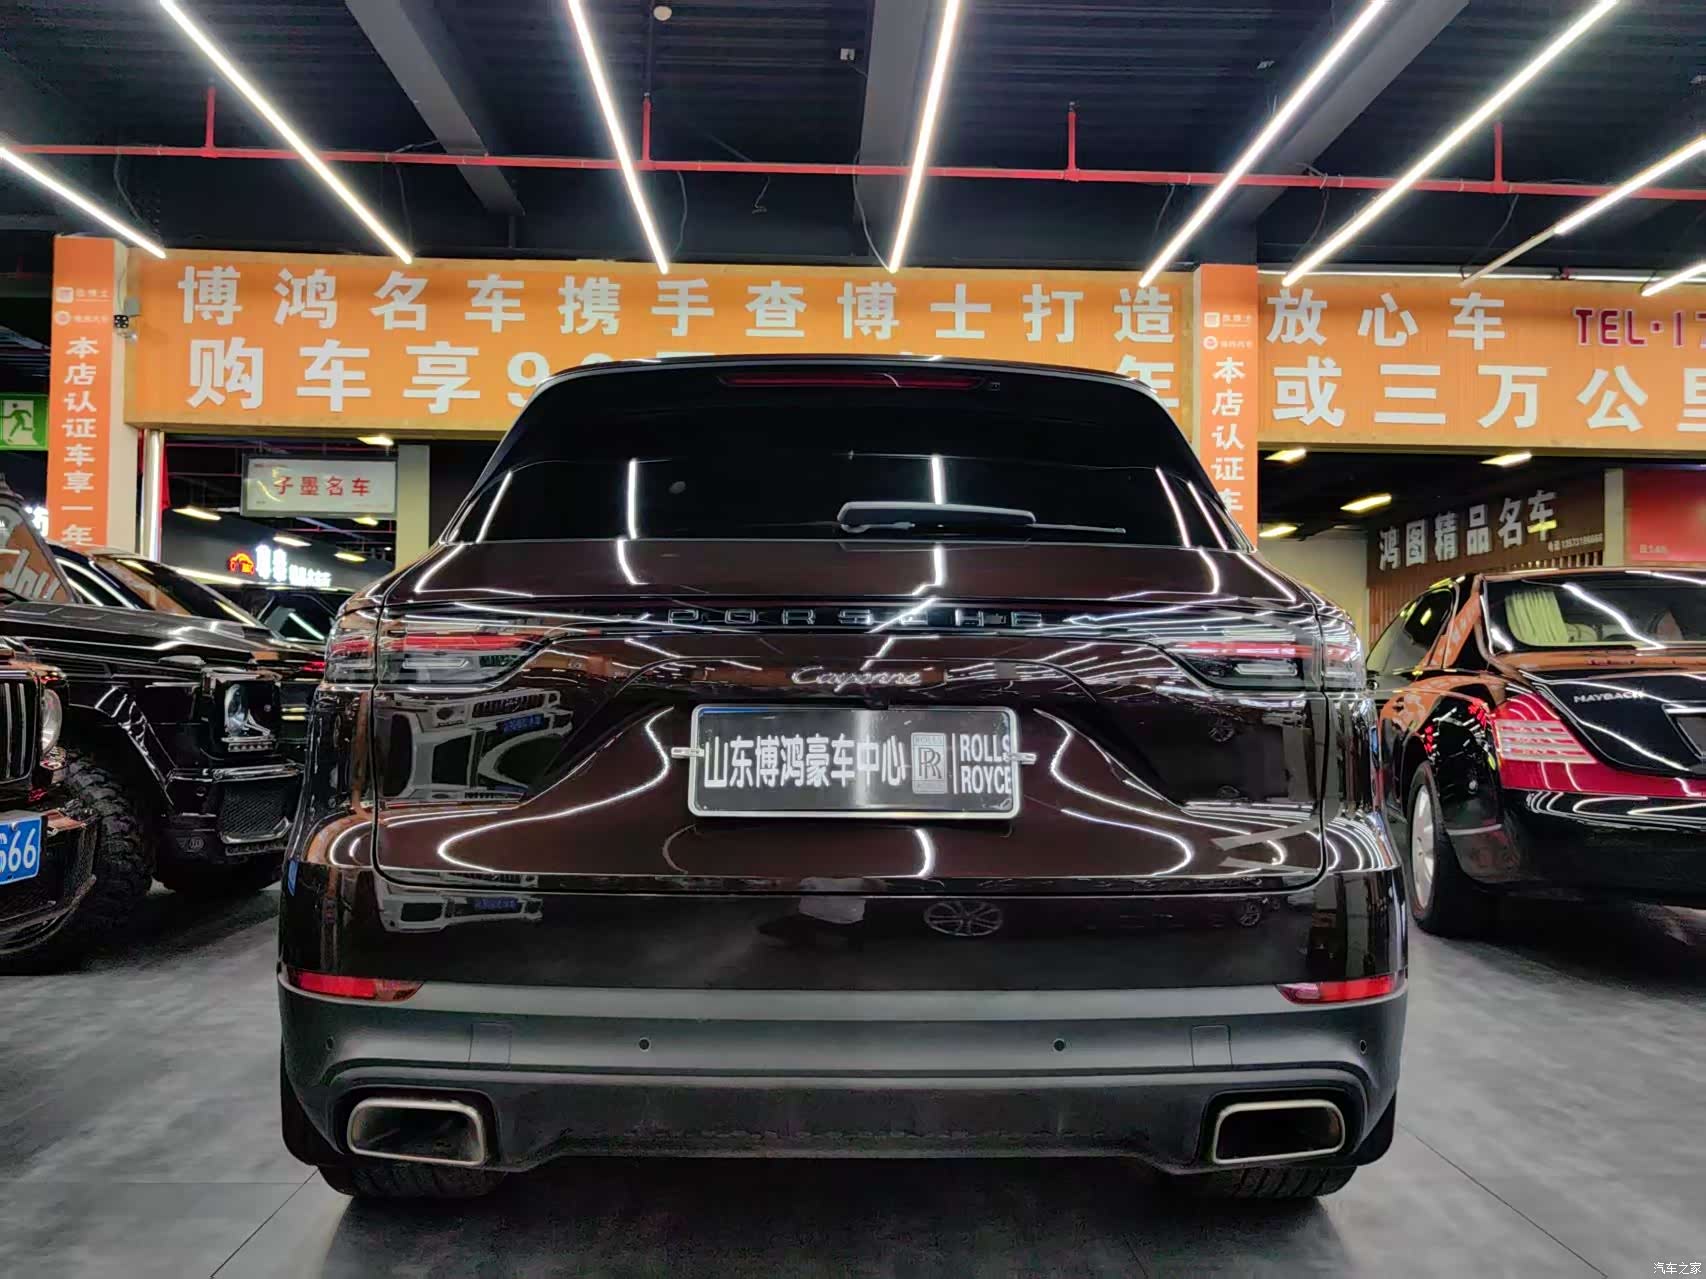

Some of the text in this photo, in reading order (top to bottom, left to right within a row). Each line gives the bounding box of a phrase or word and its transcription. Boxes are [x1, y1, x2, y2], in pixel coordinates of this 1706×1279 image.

[178, 264, 1174, 344] 博鸿名车携手查博士打造
[1266, 287, 1506, 350] 放心车
[61, 336, 99, 545] 本店认证车享一年
[1211, 356, 1245, 529] 本店认证车
[273, 476, 371, 497] 子墨名车
[1379, 489, 1557, 572] 鸿图精品名车
[667, 608, 1043, 626] PORSCHE
[791, 665, 923, 693] Cayenne
[704, 733, 906, 788] 山东博鸿豪车中心
[960, 733, 1011, 762] ROLLS
[961, 765, 1012, 794] ROYCE
